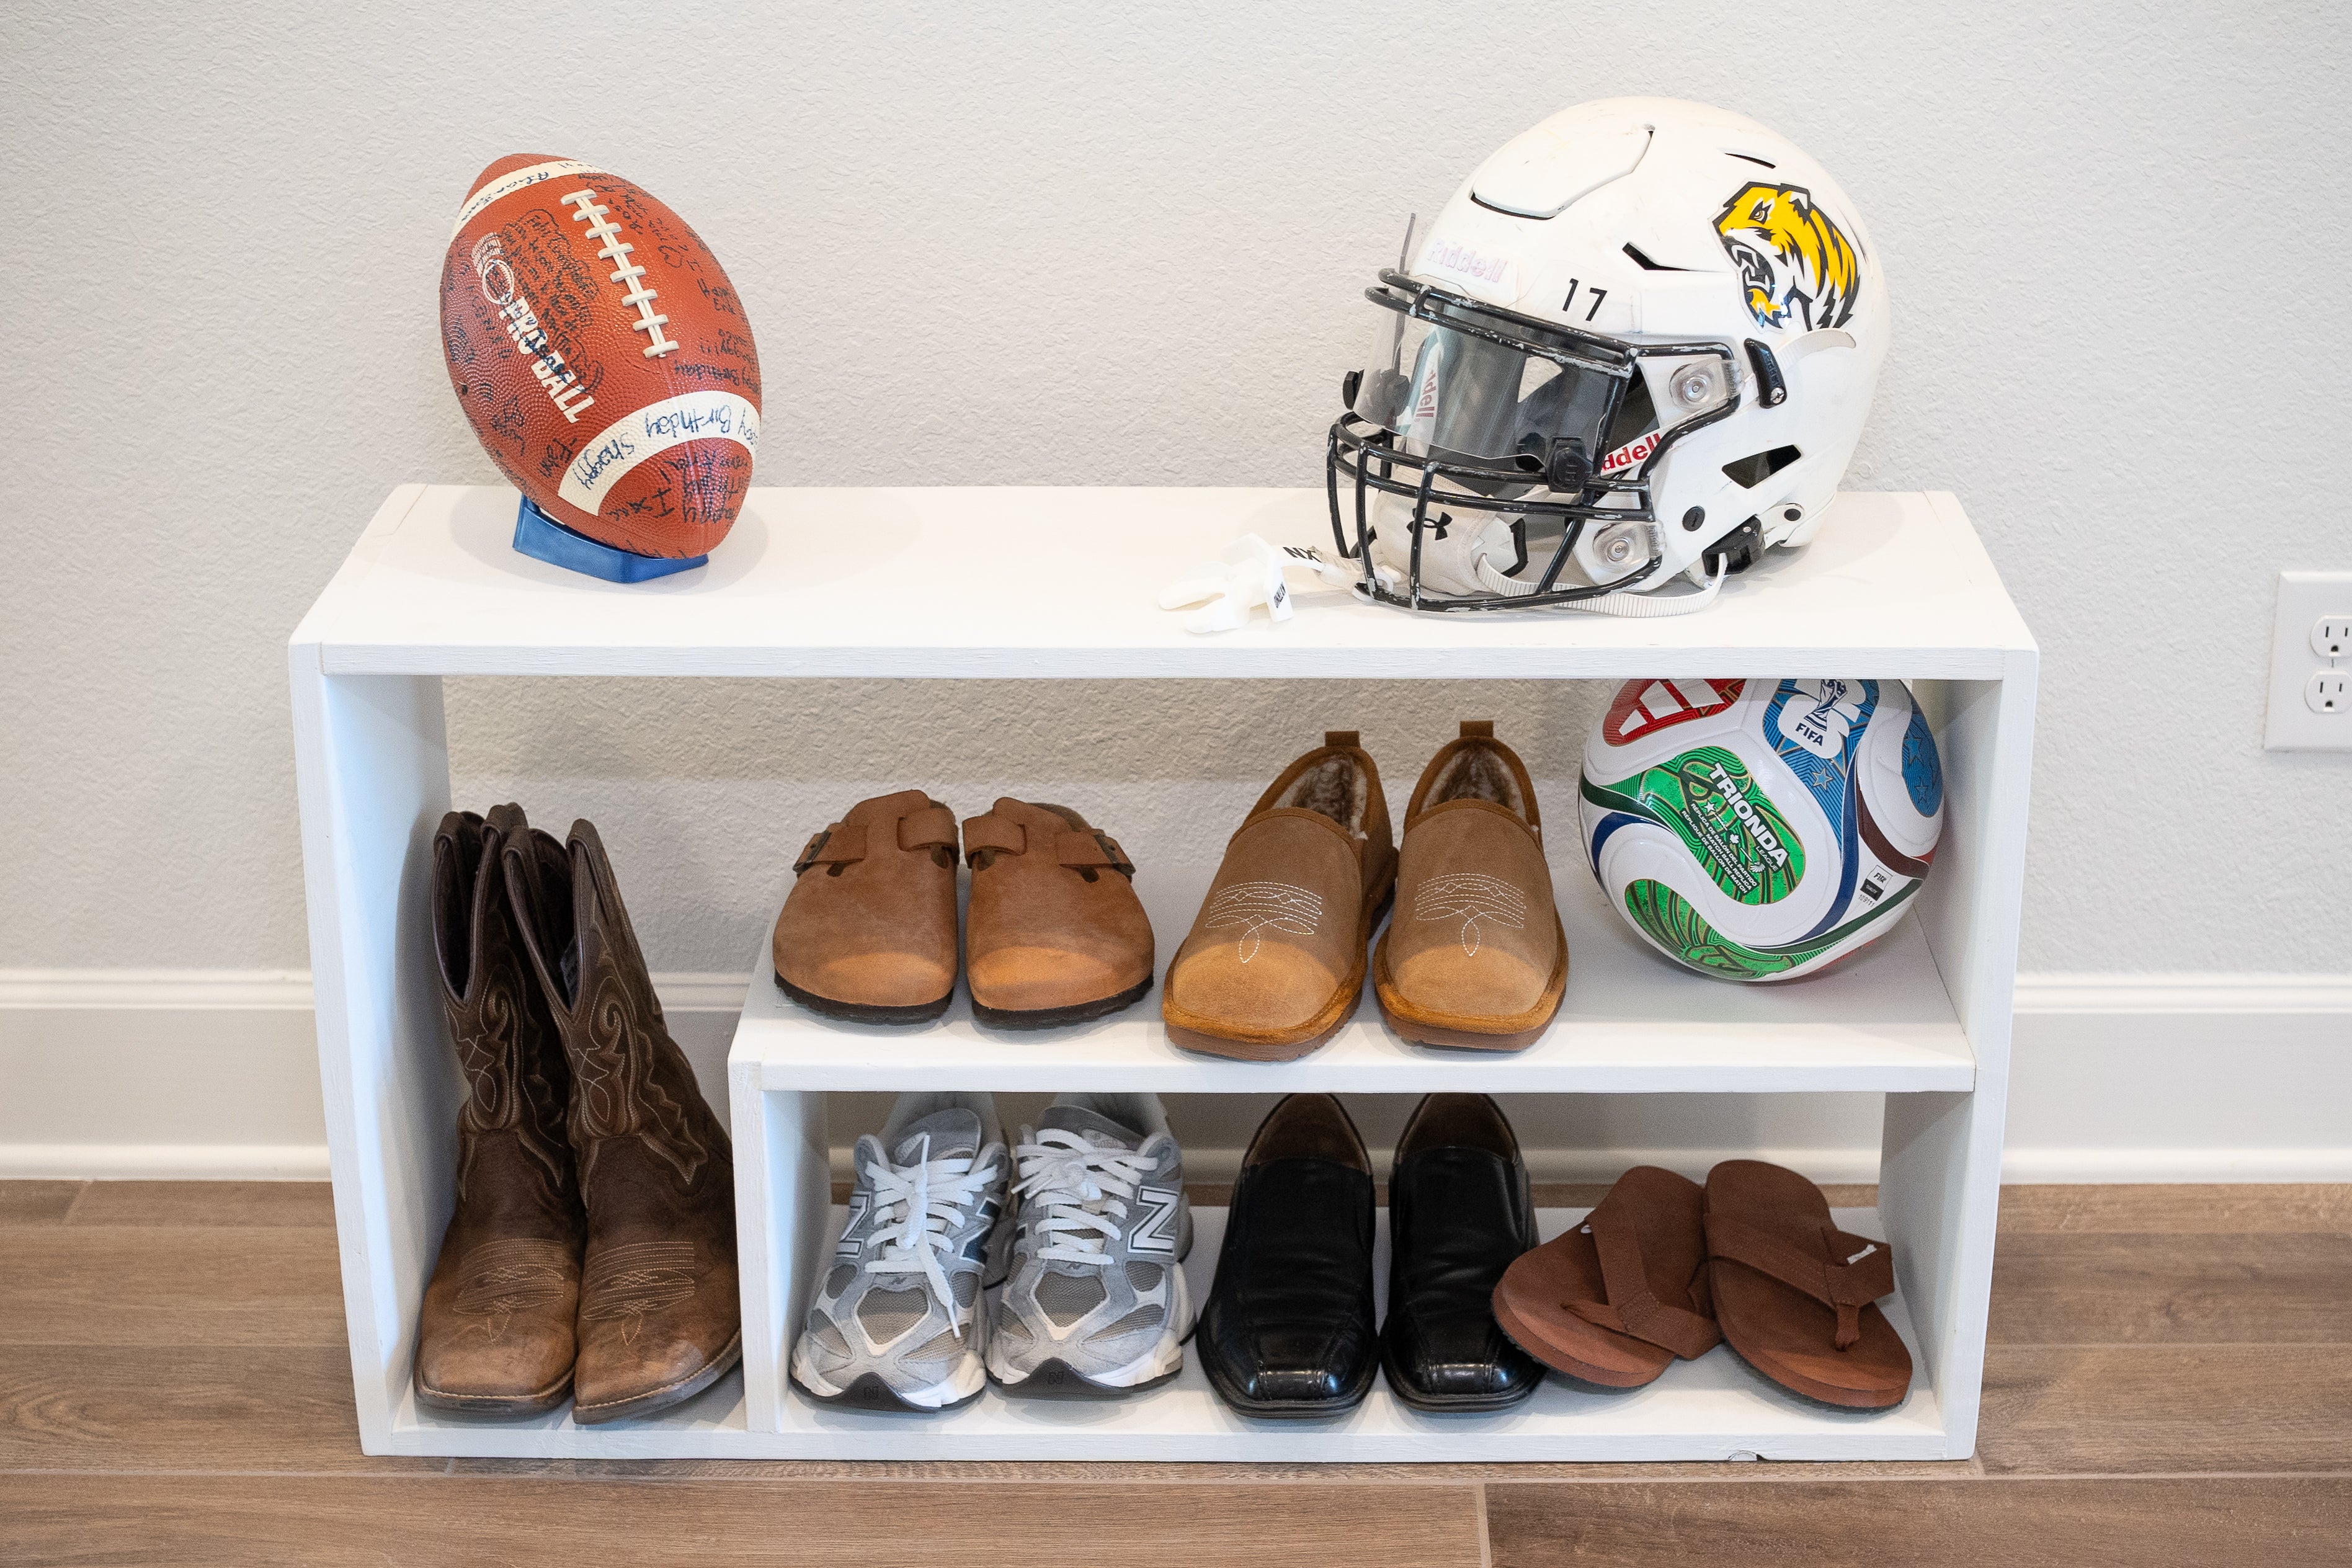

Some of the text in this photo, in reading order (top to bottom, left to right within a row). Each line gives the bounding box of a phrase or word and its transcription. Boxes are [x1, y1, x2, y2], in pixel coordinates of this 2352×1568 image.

[1562, 278, 1608, 321] 17
[497, 296, 549, 355] PRO
[530, 349, 595, 422] BALL
[645, 404, 731, 438] Birthday
[572, 432, 635, 490] Shaggy
[1795, 722, 1824, 747] FIFA
[1709, 762, 1788, 868] TRIONDA
[1701, 837, 1709, 846] DE
[1707, 845, 1726, 868] BALLON
[1724, 866, 1732, 875] DE
[1730, 874, 1748, 894] MATCH
[1706, 834, 1752, 890] MATCH BALL REPLICA
[1708, 826, 1716, 835] DE
[1714, 834, 1731, 854] BALÓN
[1728, 853, 1738, 865] DEL
[1737, 863, 1758, 886] PARTIDO
[1755, 845, 1779, 871] LEAGUE
[1874, 872, 1886, 883] FIFA
